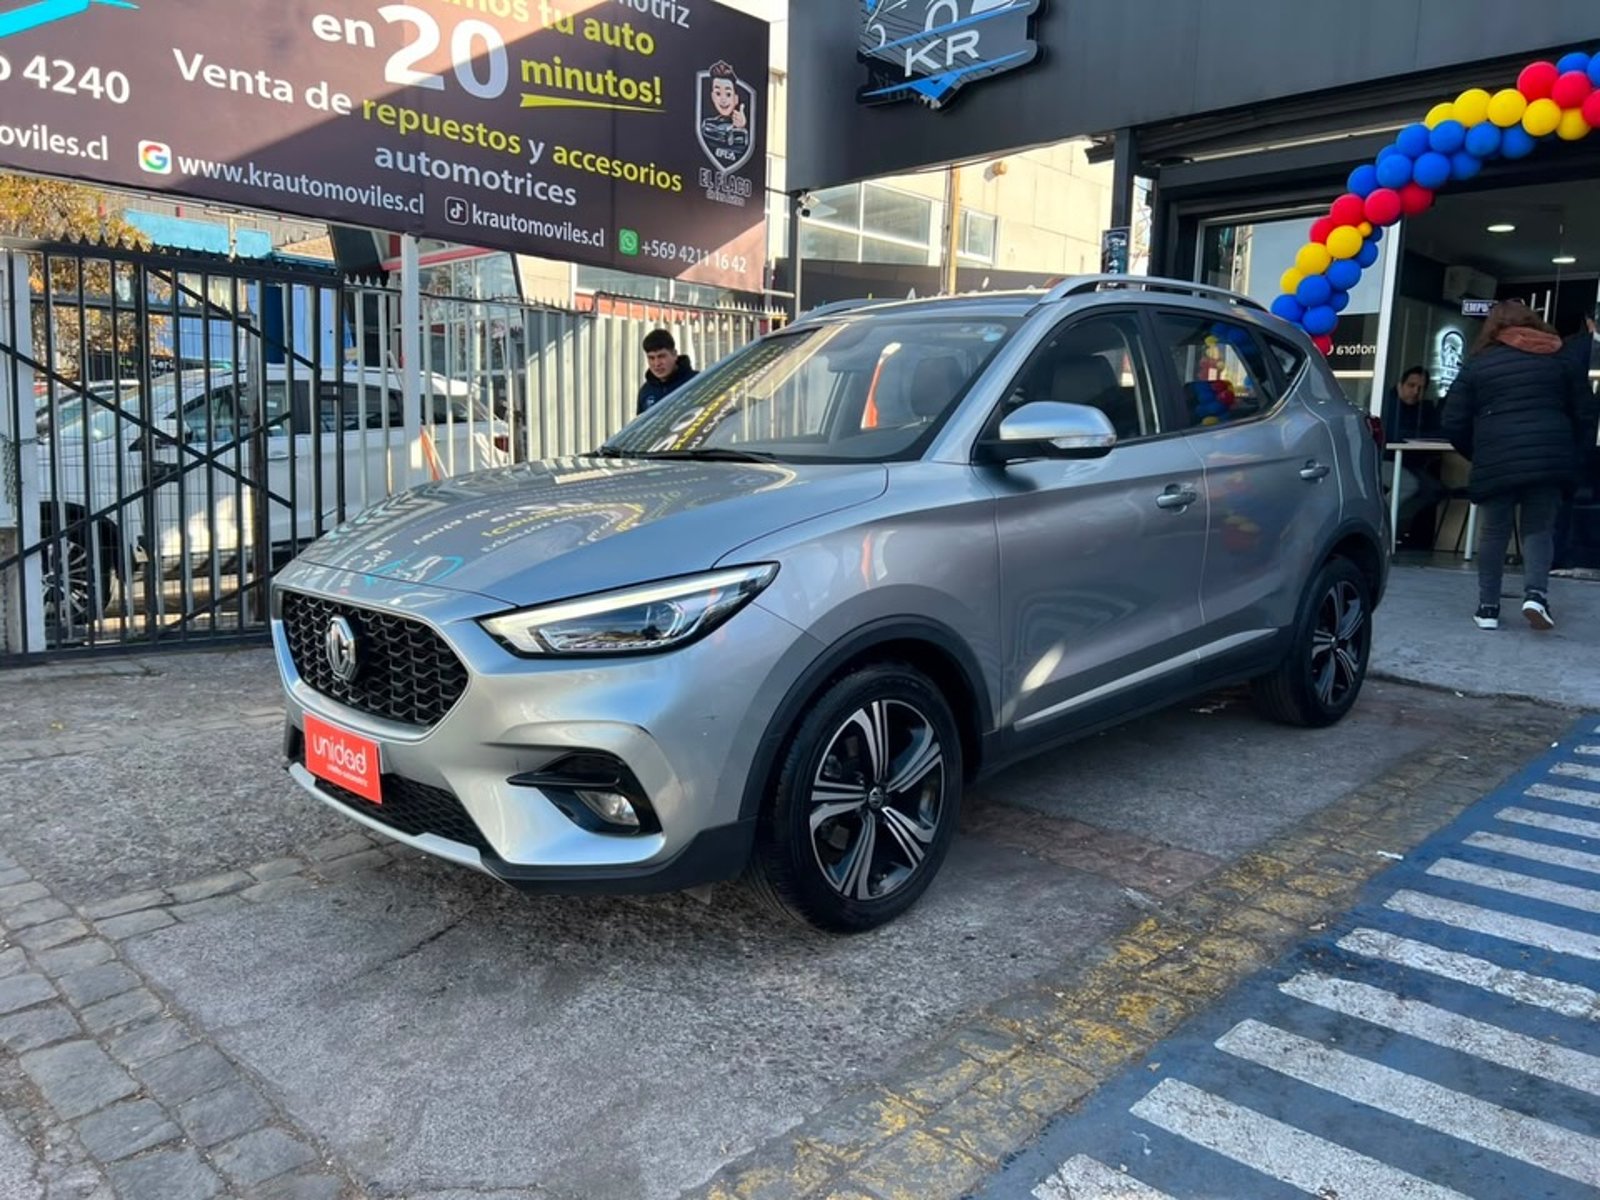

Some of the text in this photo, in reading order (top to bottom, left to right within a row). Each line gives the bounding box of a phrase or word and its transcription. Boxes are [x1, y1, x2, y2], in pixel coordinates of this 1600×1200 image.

[539, 4, 575, 35] tu
[583, 16, 655, 55] auto
[619, 0, 690, 29] otriz
[311, 4, 663, 105] en 20 minutos!
[904, 29, 980, 78] KR
[22, 55, 131, 104] 4240
[172, 48, 684, 193] Venta de repuestos y accesorios
[177, 155, 424, 215] www.krautomoviles.cl
[374, 147, 578, 206] automotrices
[699, 167, 714, 189] EL
[472, 203, 605, 248] krautomoviles.cl
[641, 239, 676, 260] +569
[679, 245, 710, 267] 4211
[731, 254, 747, 273] 42
[312, 733, 368, 776] unidad
